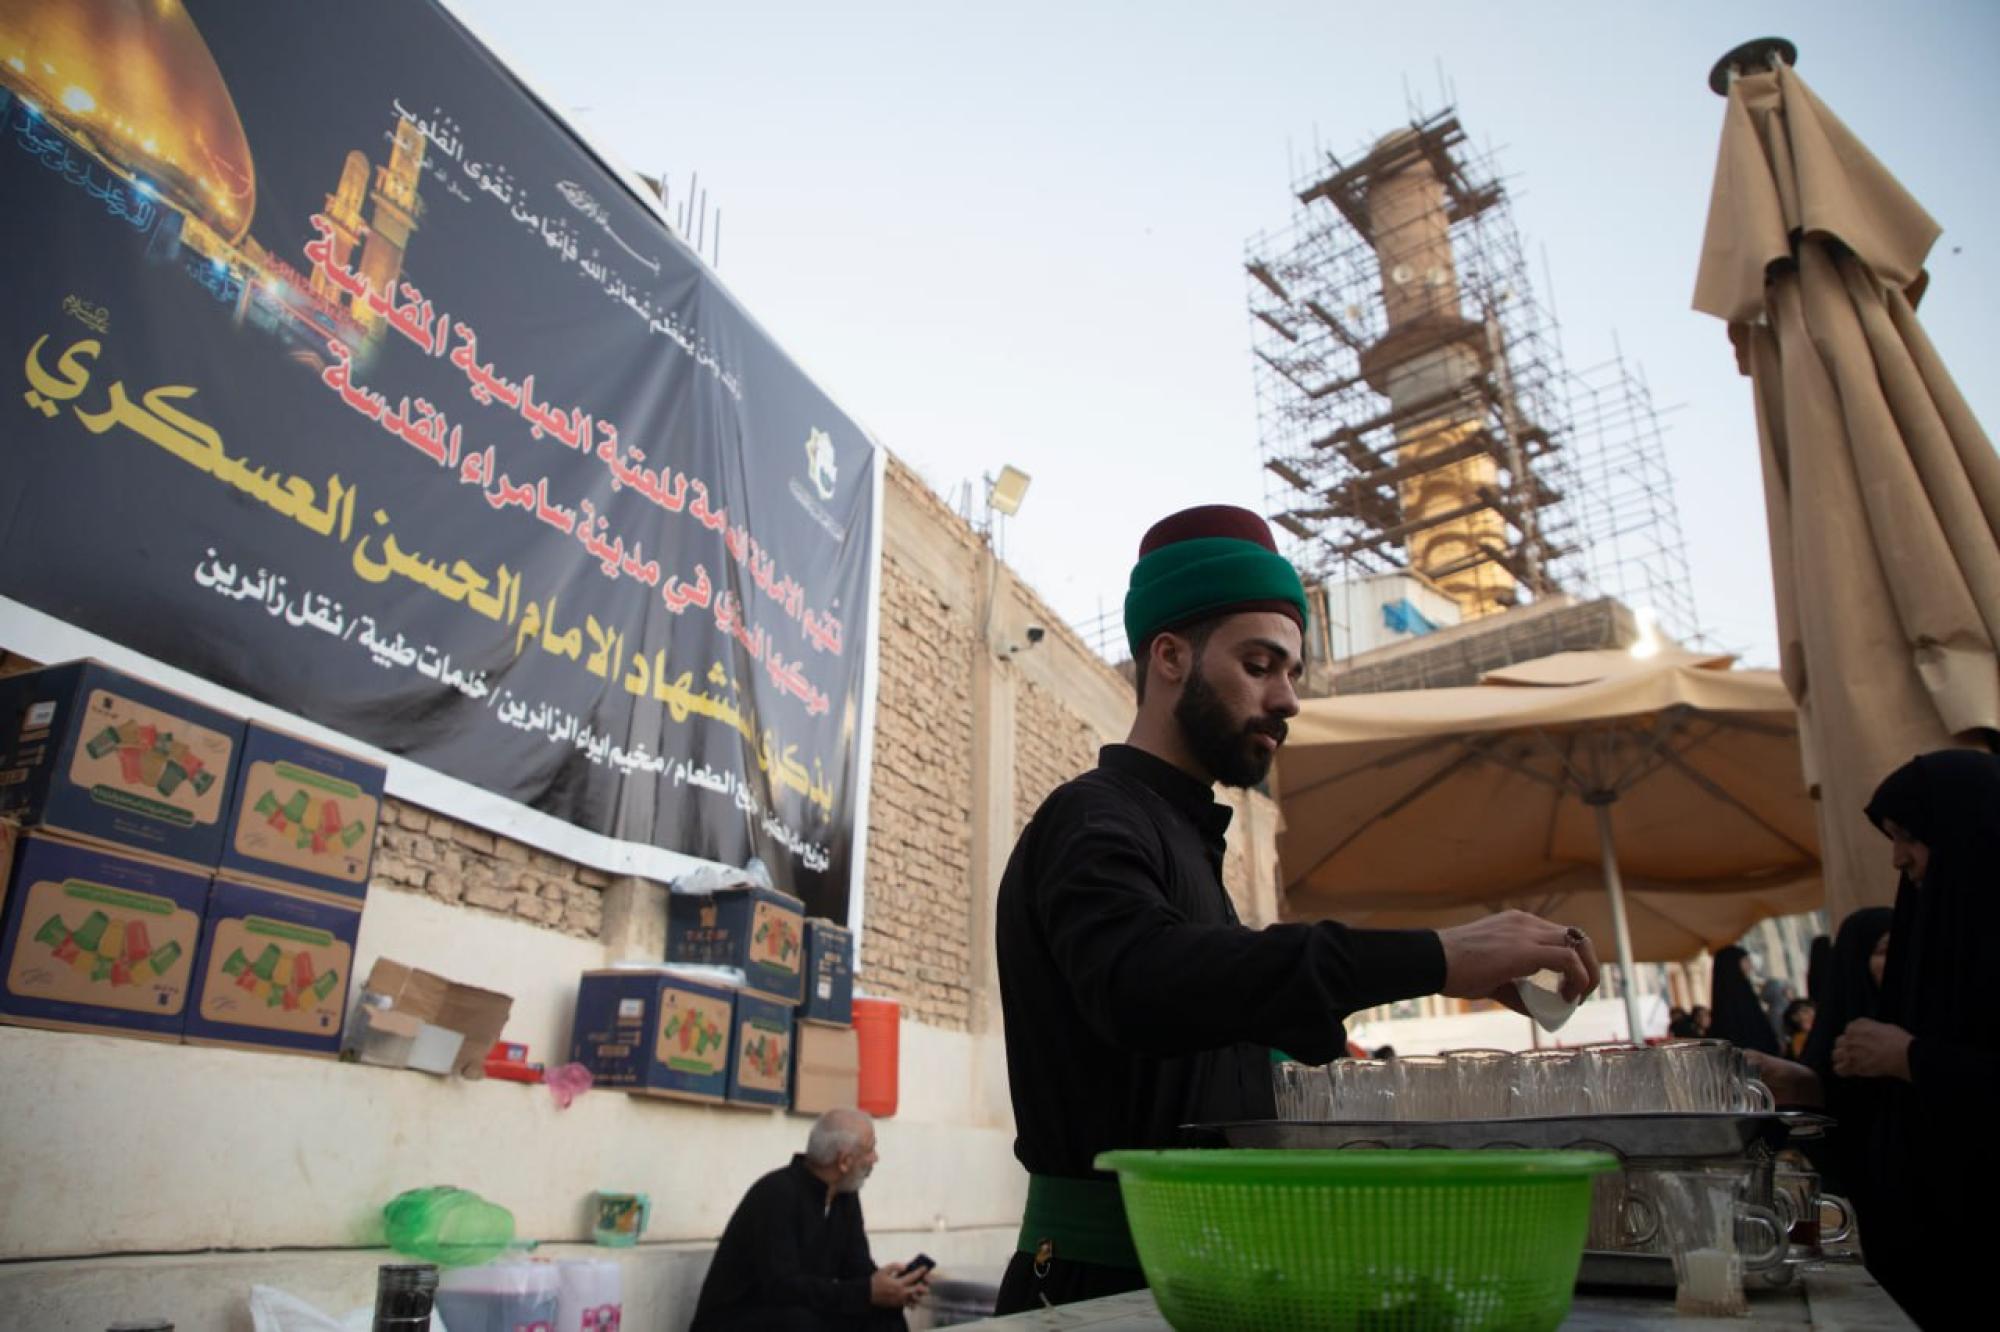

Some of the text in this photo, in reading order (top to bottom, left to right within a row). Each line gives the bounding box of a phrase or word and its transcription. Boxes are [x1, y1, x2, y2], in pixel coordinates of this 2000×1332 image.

[303, 213, 450, 357] المقدسة
[321, 338, 462, 468] المقدسة
[449, 321, 592, 455] العباسية
[24, 333, 357, 544] العسكري
[596, 419, 689, 513] للعتبة
[460, 444, 577, 535] سامراء
[194, 547, 288, 617] زائرين
[352, 508, 522, 626] الحسن
[576, 498, 661, 588] مدينة
[285, 590, 345, 636] نقل
[662, 563, 712, 616] في
[358, 614, 416, 669] طبية
[416, 645, 490, 700] خدمات
[516, 596, 625, 683] الامام
[497, 691, 578, 743] الزائرين
[608, 742, 664, 775] مخيم
[674, 759, 736, 795] الطعام
